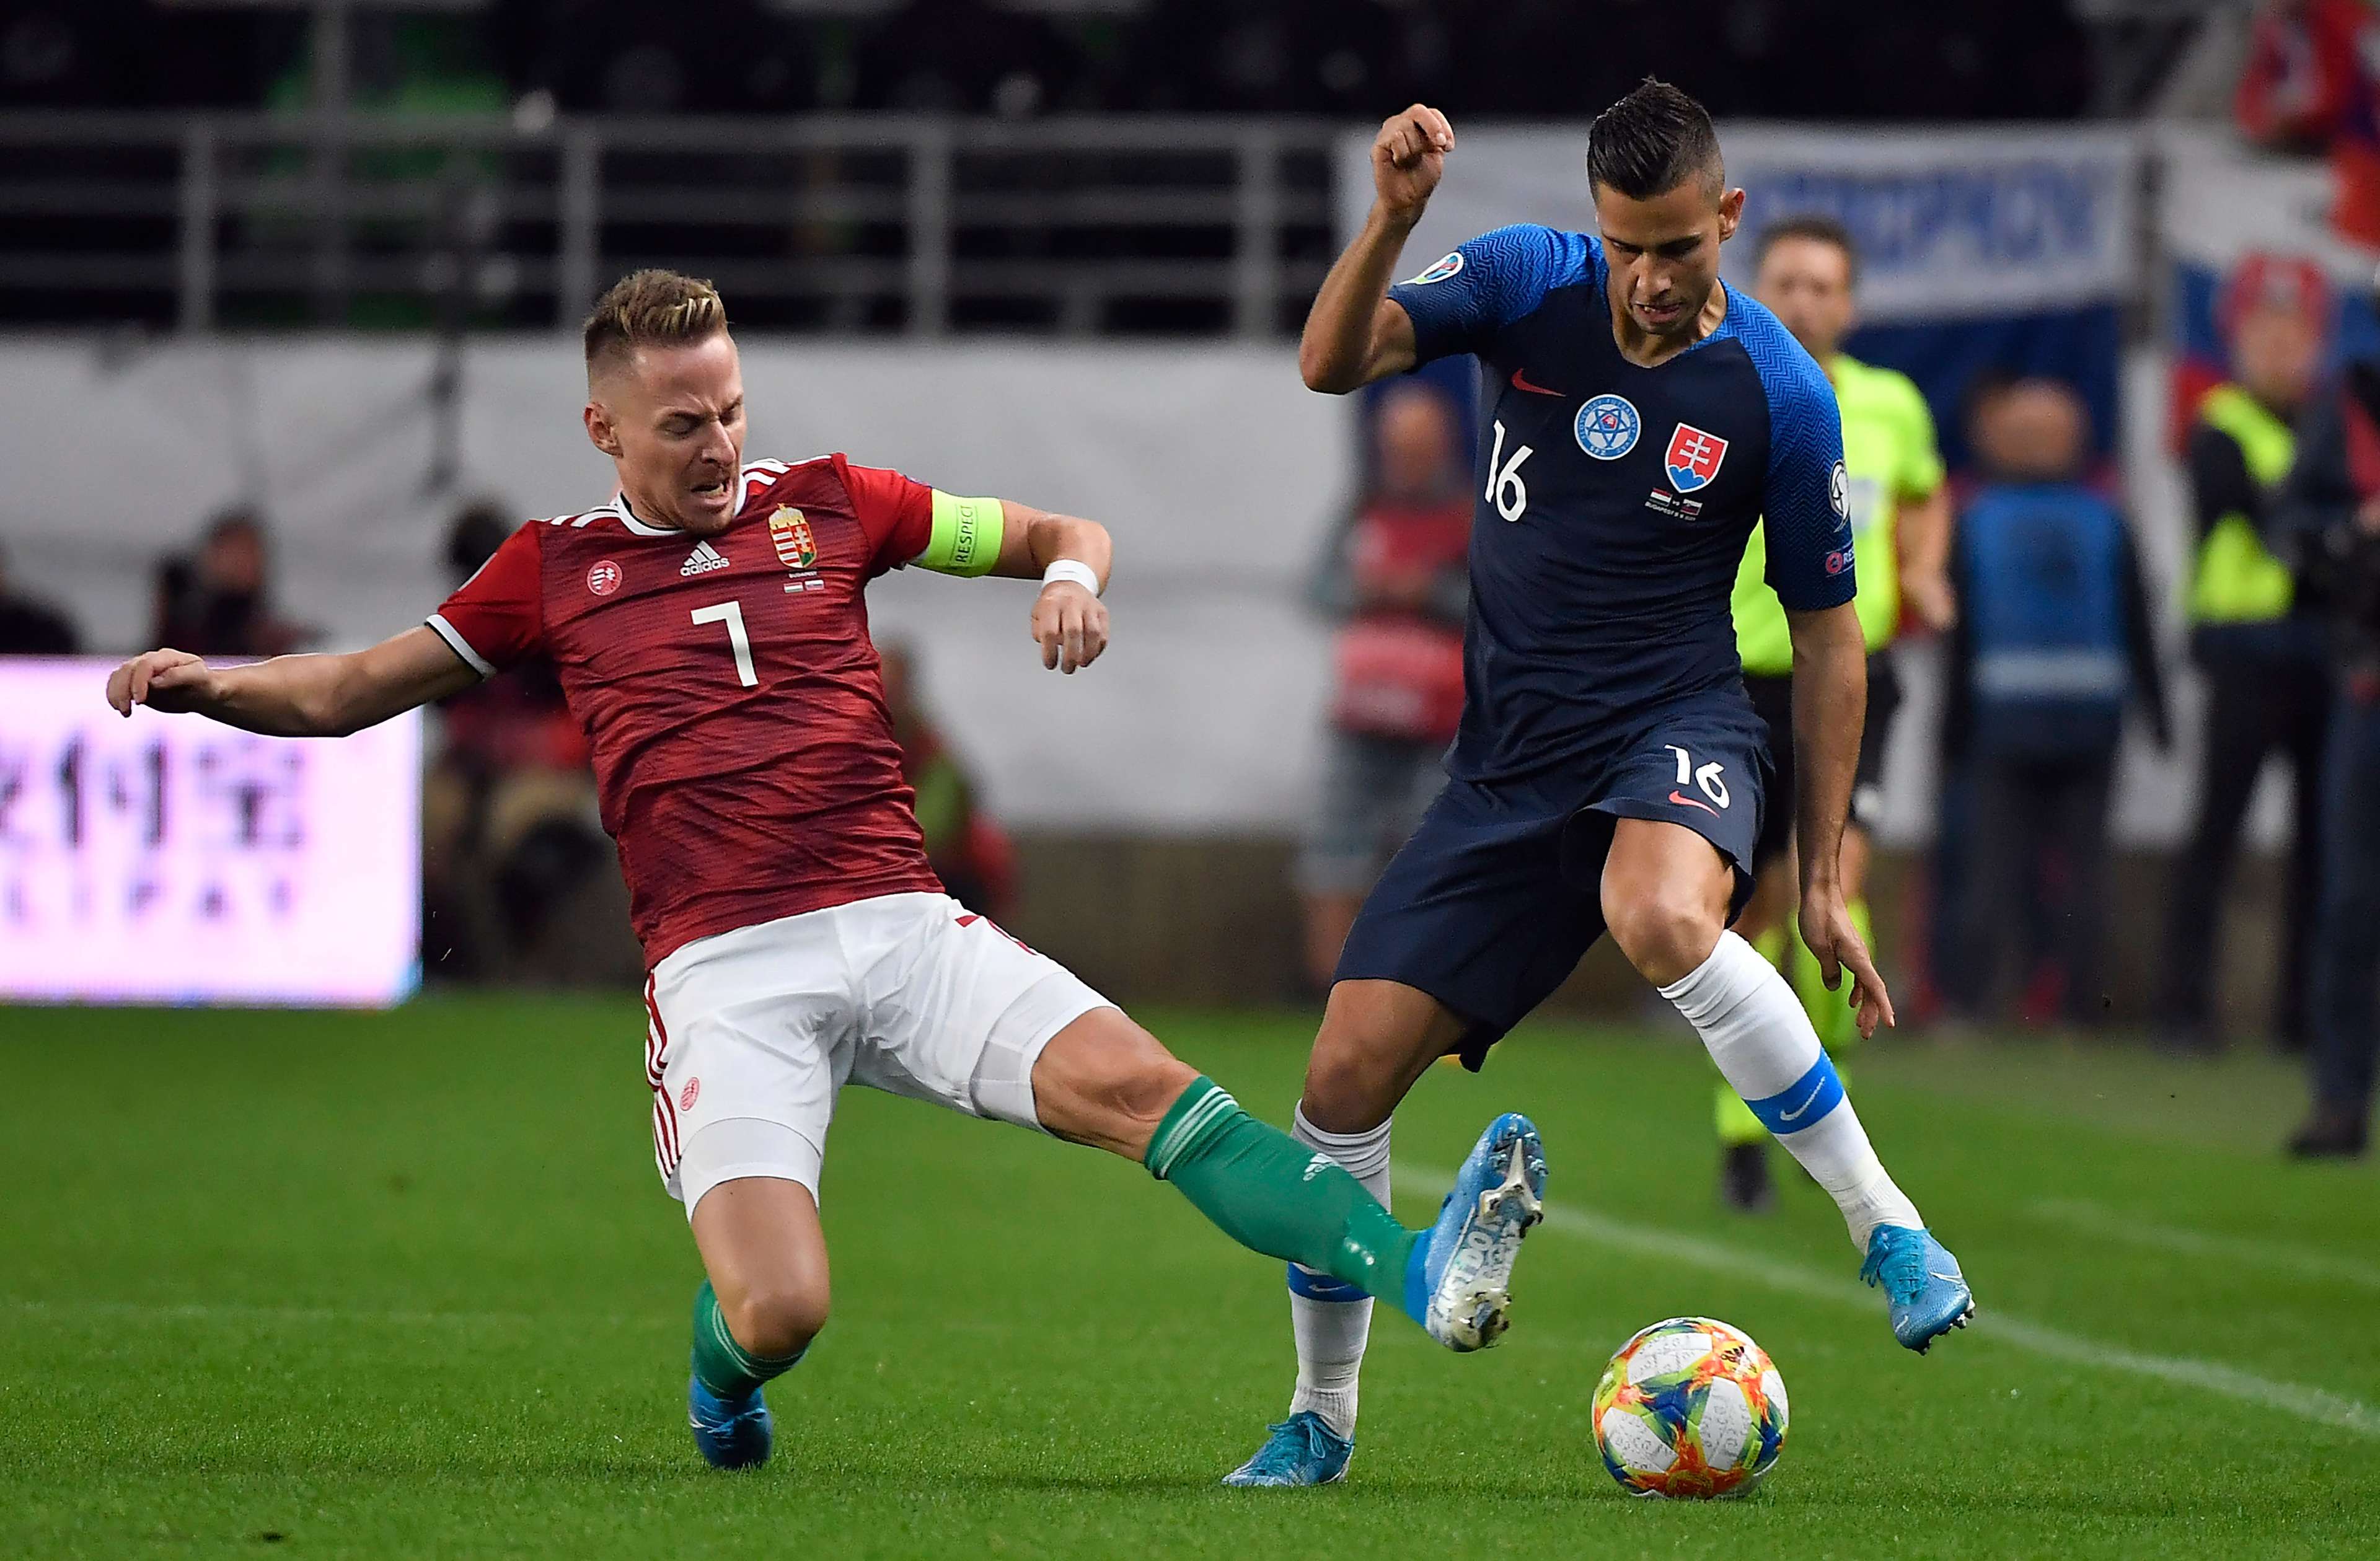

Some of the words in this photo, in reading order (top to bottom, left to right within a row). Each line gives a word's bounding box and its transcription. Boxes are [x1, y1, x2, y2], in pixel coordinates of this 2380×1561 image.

[1485, 419, 1534, 522] 16
[679, 557, 730, 576] adidas
[955, 505, 973, 563] RESPECT
[690, 600, 759, 687] 7
[1664, 744, 1730, 809] 16
